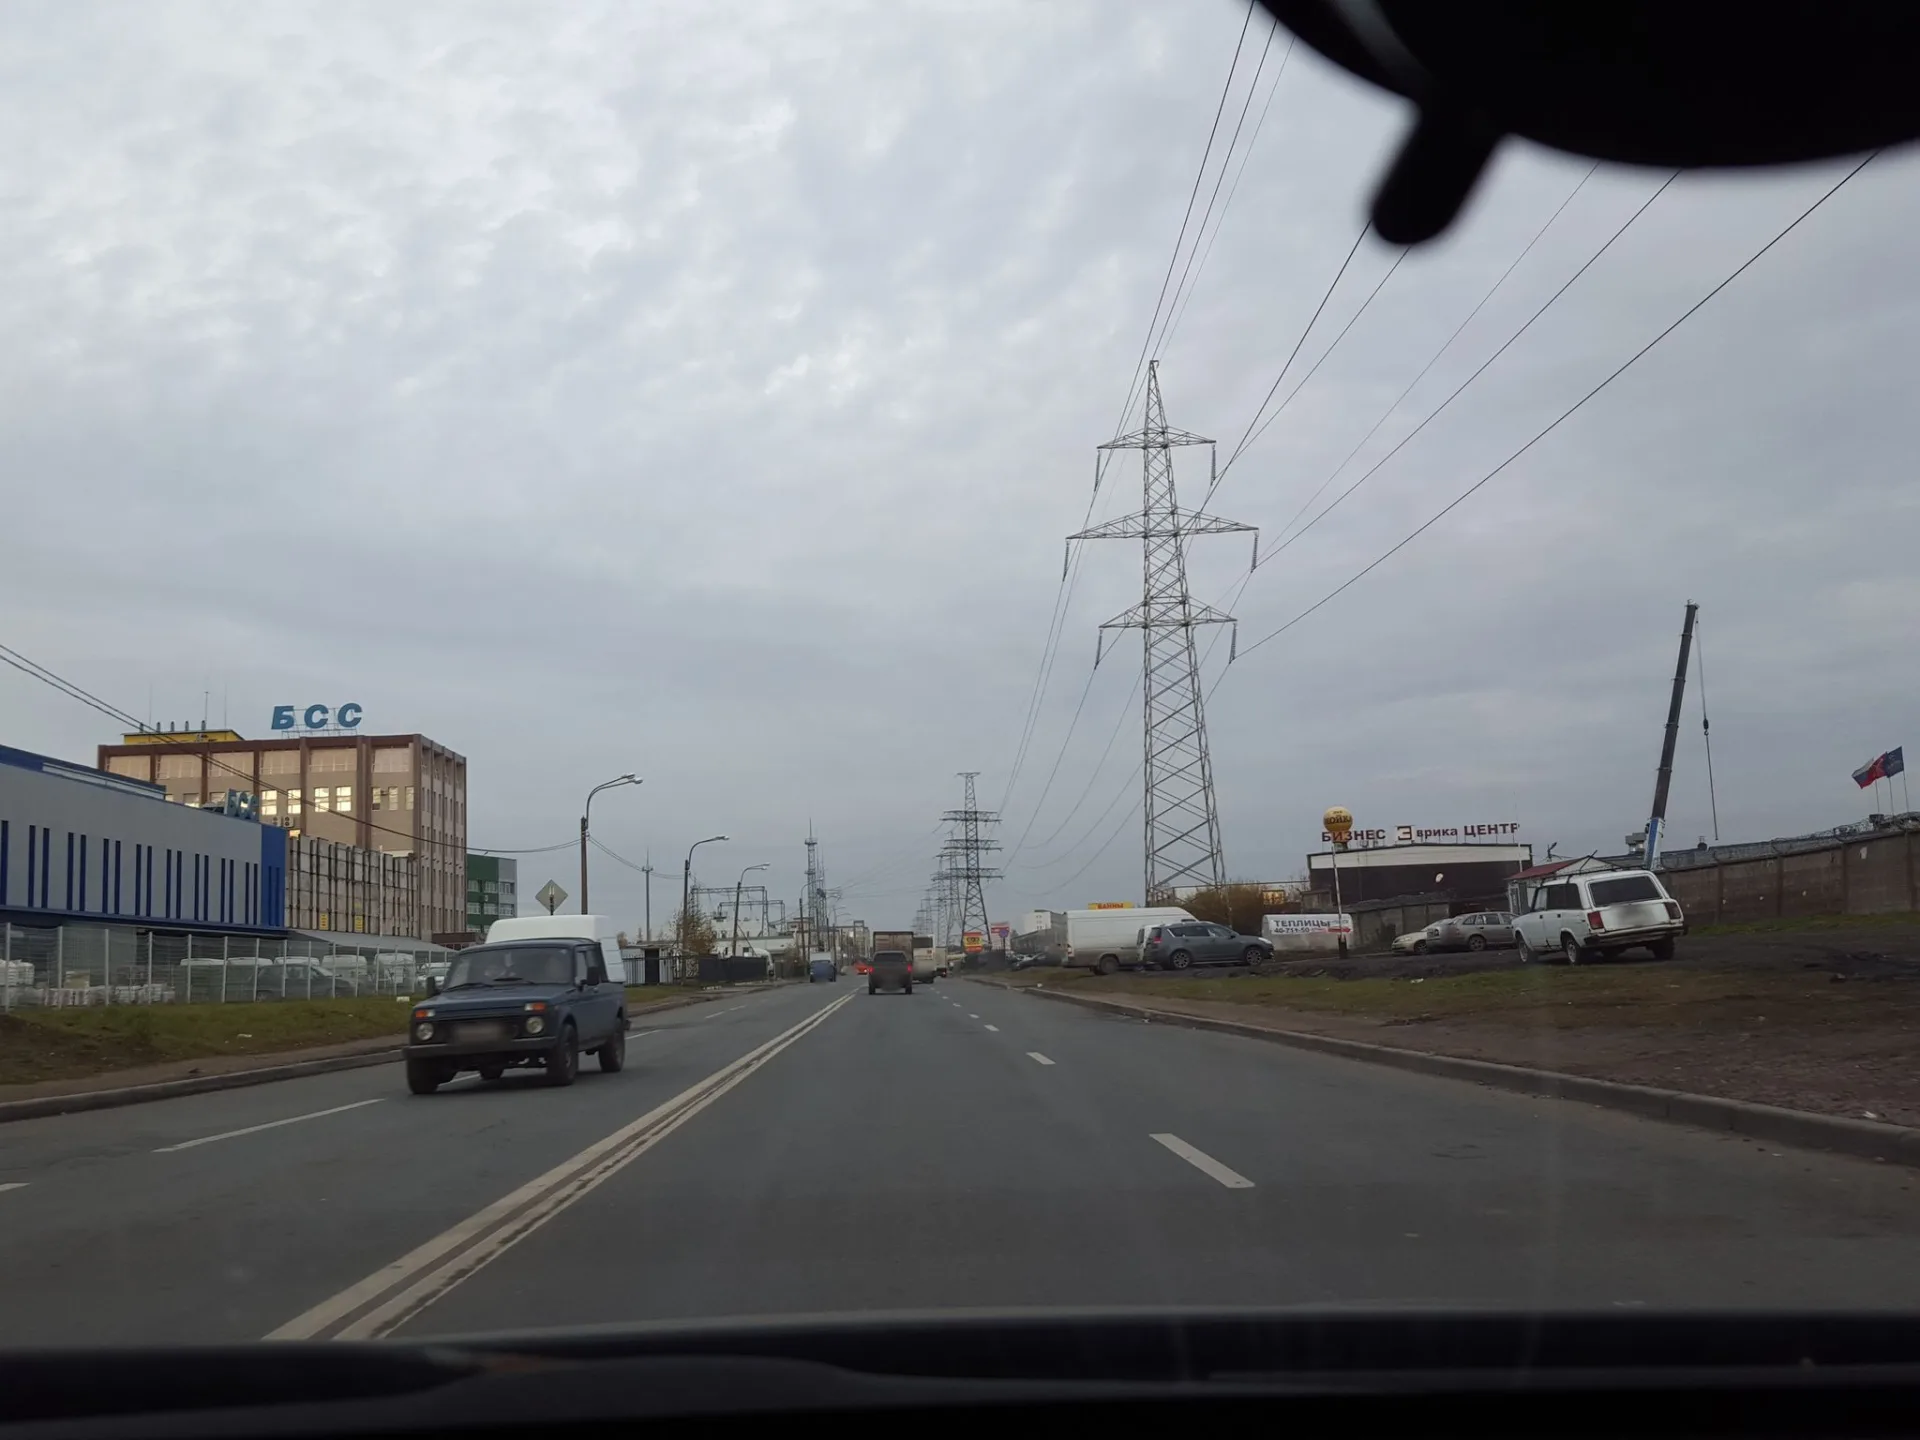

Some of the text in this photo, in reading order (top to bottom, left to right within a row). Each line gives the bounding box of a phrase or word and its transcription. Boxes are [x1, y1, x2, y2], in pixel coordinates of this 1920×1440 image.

[271, 703, 363, 730] БСС
[1321, 829, 1386, 842] БИЗНЕС
[1463, 822, 1520, 838] ЦЕНТР
[1274, 919, 1331, 929] ТЕПЛИЦЫ
